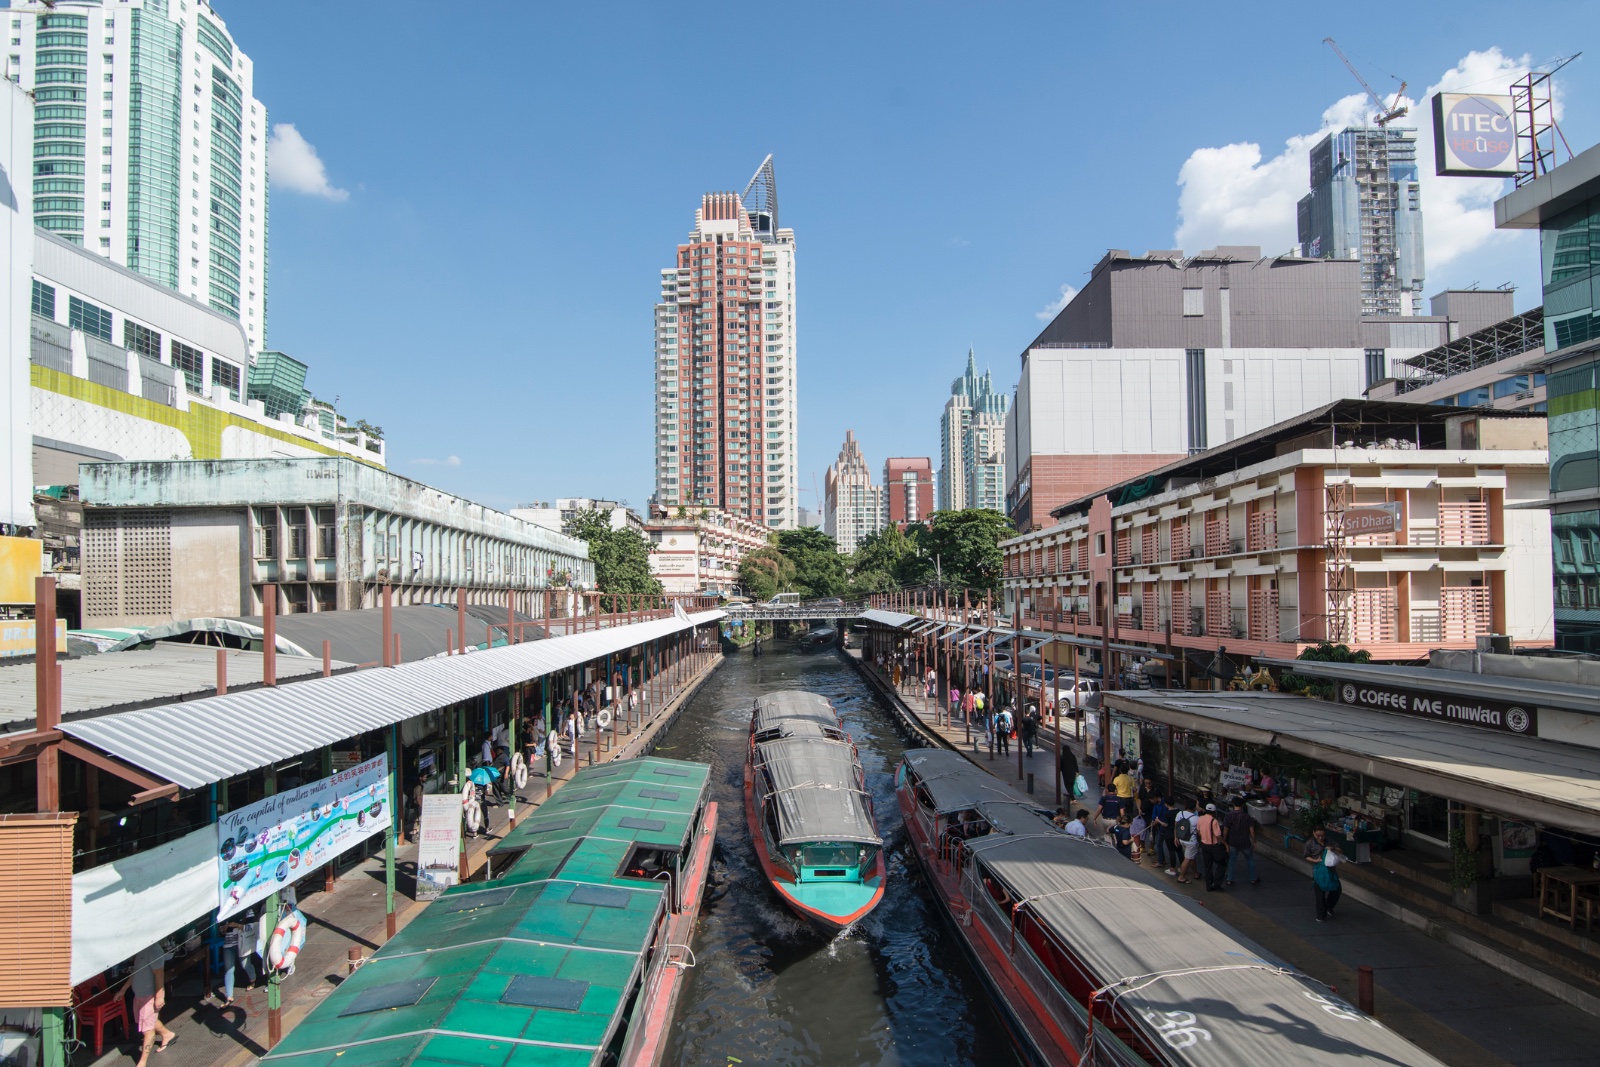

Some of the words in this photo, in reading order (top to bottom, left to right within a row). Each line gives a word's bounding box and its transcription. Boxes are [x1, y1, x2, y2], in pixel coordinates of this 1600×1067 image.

[1451, 112, 1508, 133] ITEC
[1346, 517, 1359, 530] Sri
[1361, 515, 1392, 528] Dhara
[1359, 688, 1407, 710] COFFEE
[1413, 697, 1442, 715] ME
[1446, 703, 1501, 725] กาแฟสด
[224, 811, 245, 832] The
[246, 798, 276, 825] capital
[277, 795, 286, 814] of
[310, 781, 327, 796] smiles
